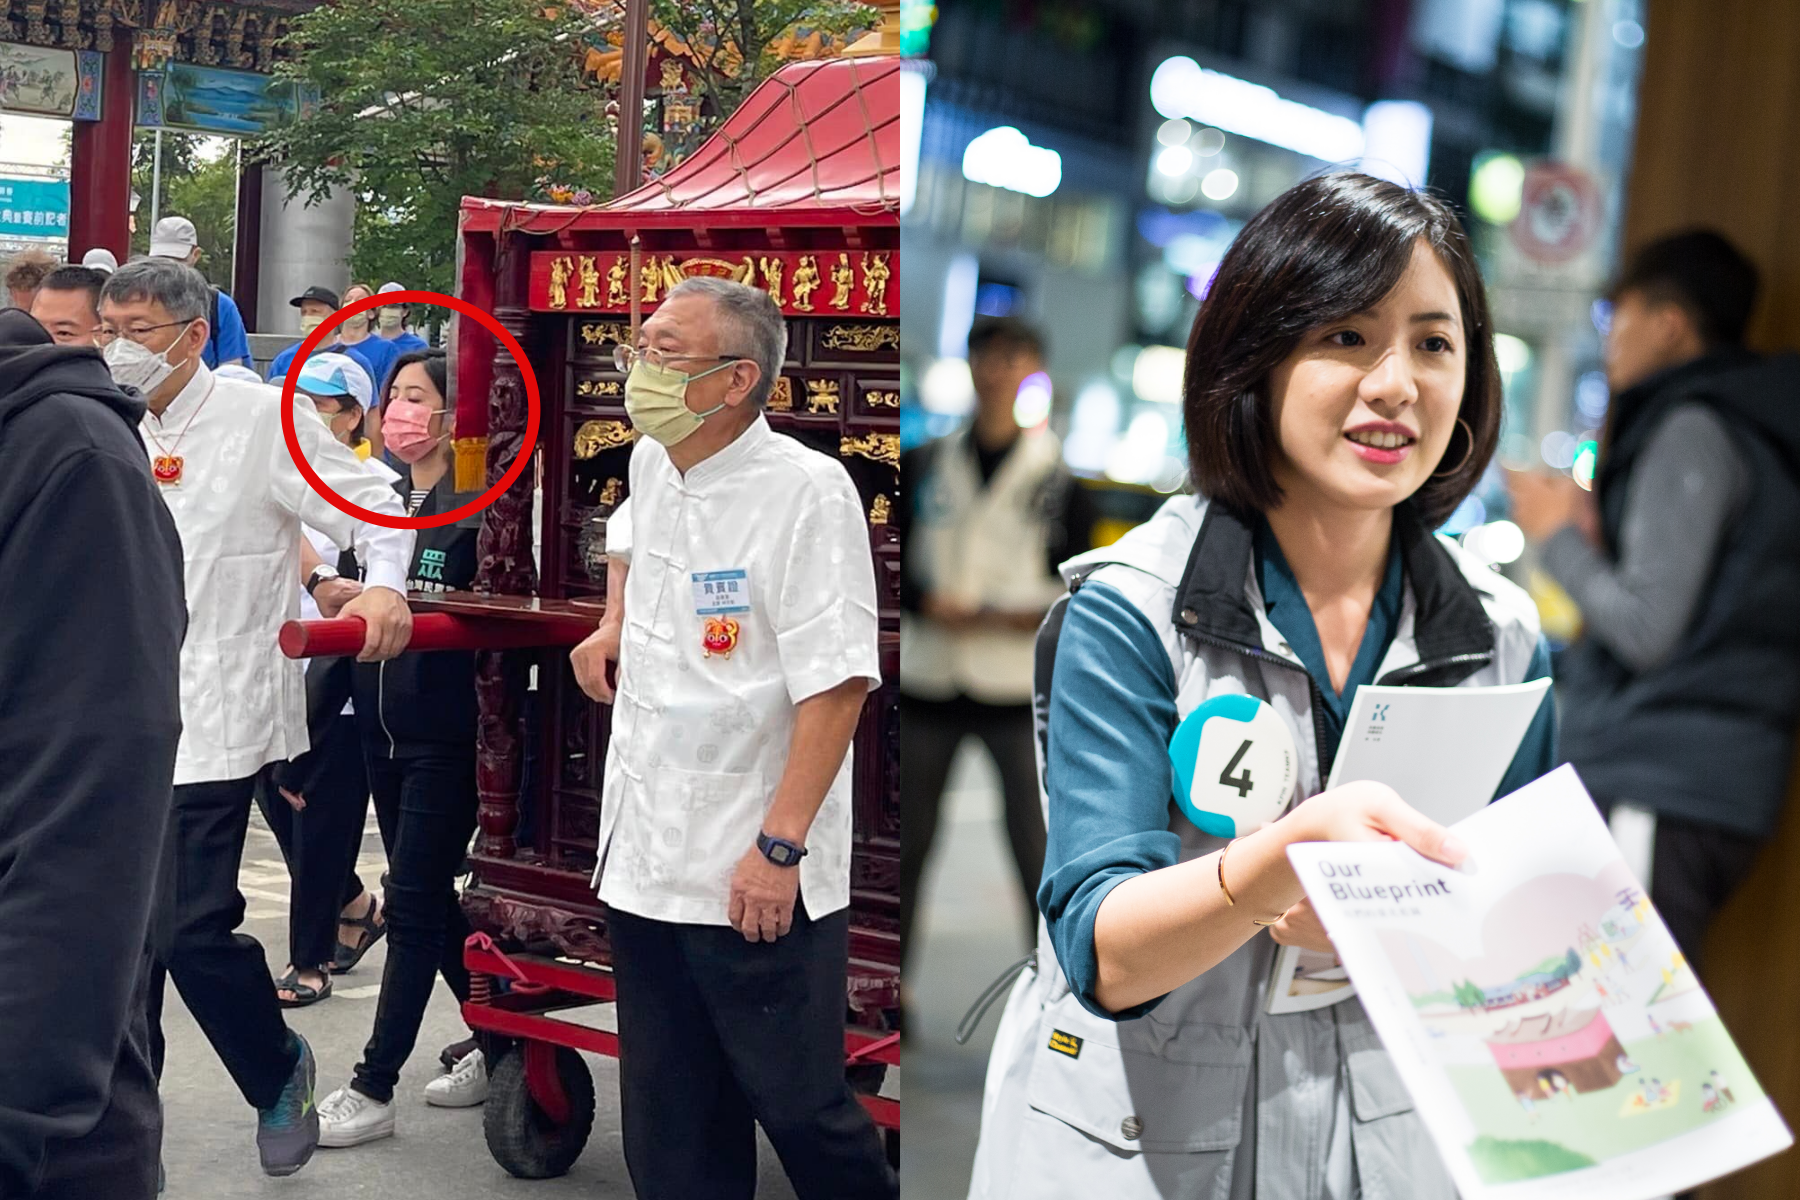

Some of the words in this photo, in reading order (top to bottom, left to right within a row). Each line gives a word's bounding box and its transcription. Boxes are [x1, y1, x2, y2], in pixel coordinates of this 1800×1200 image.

[0, 208, 67, 227] 典暨賽前記者
[417, 548, 446, 581] 眾
[1219, 739, 1254, 798] 4
[1318, 860, 1361, 878] Our
[1329, 878, 1452, 903] Blueprint
